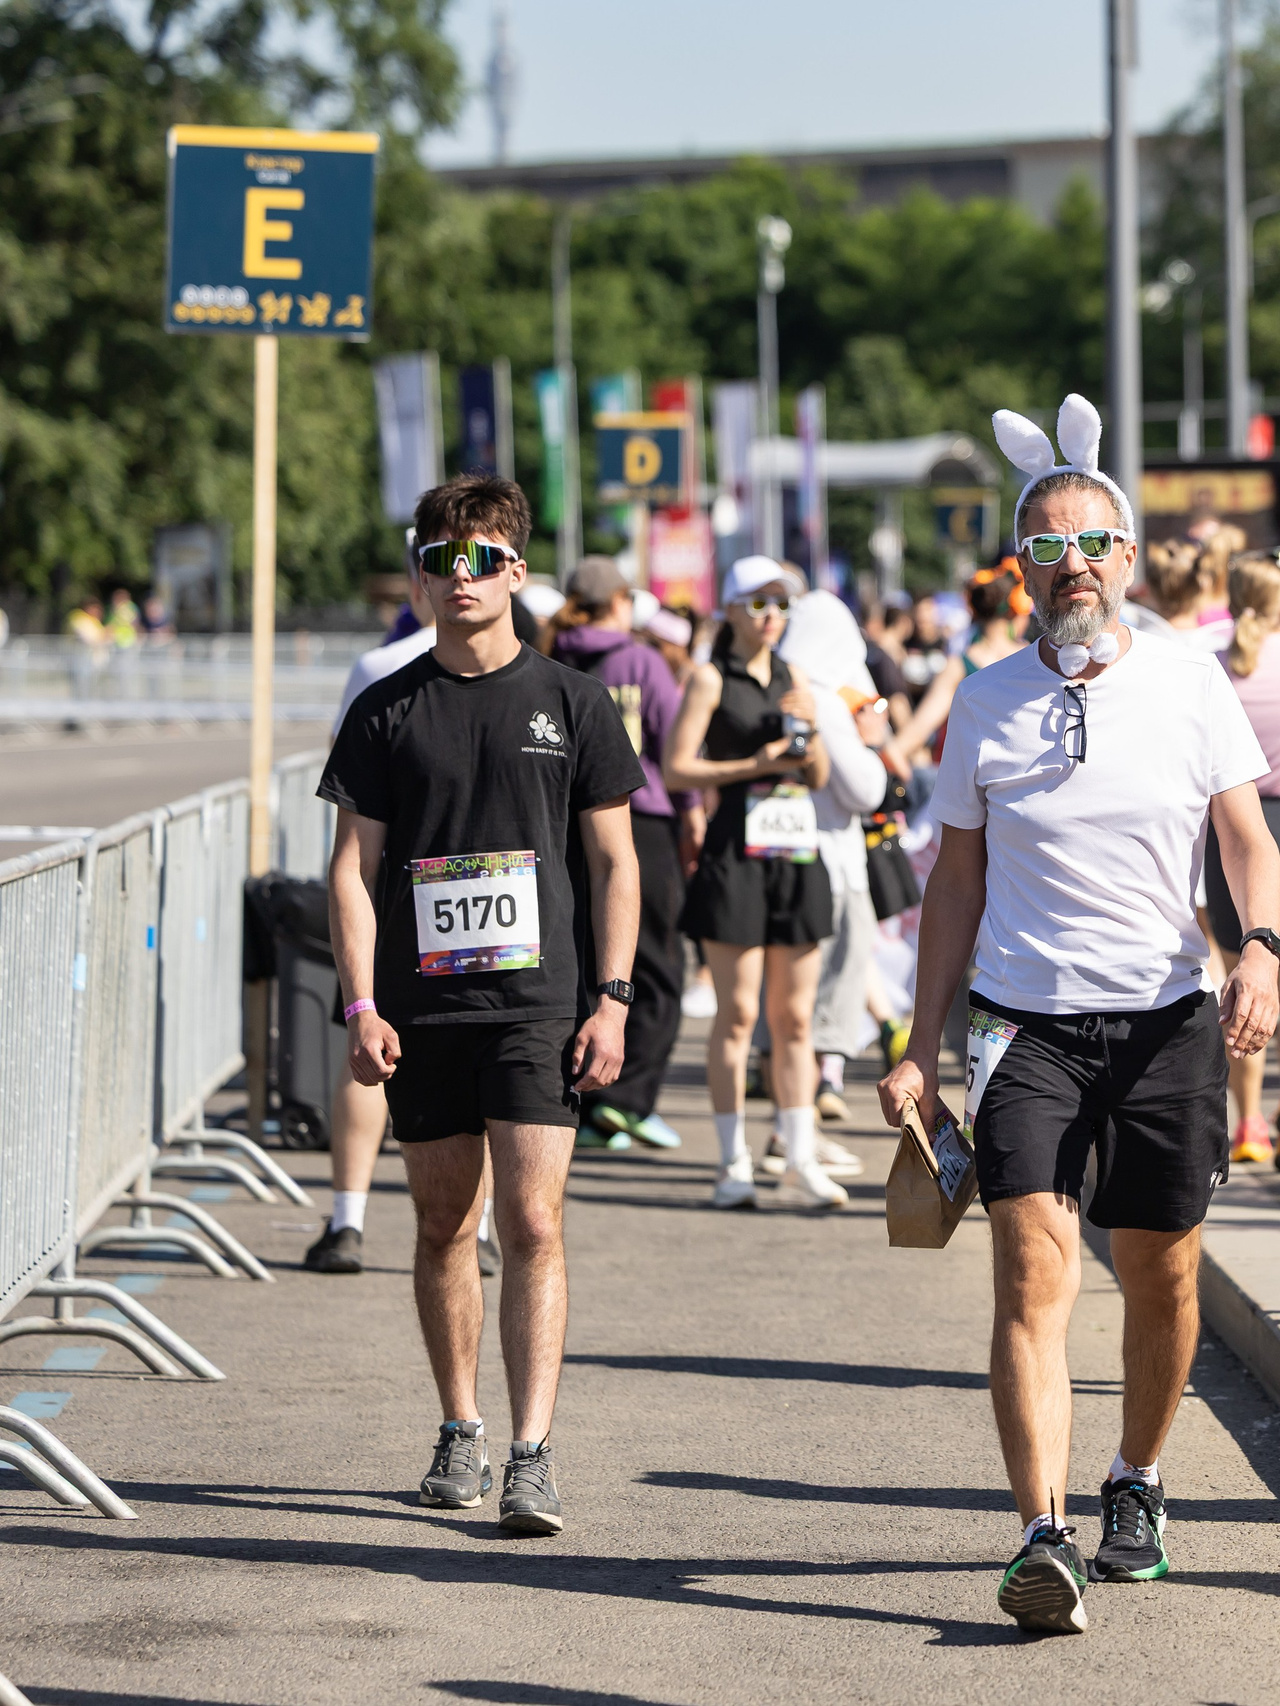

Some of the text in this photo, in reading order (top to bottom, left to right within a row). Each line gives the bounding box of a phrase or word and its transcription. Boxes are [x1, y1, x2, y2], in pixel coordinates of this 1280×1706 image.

[243, 186, 305, 280] E
[623, 437, 662, 486] D
[433, 893, 517, 934] 5170
